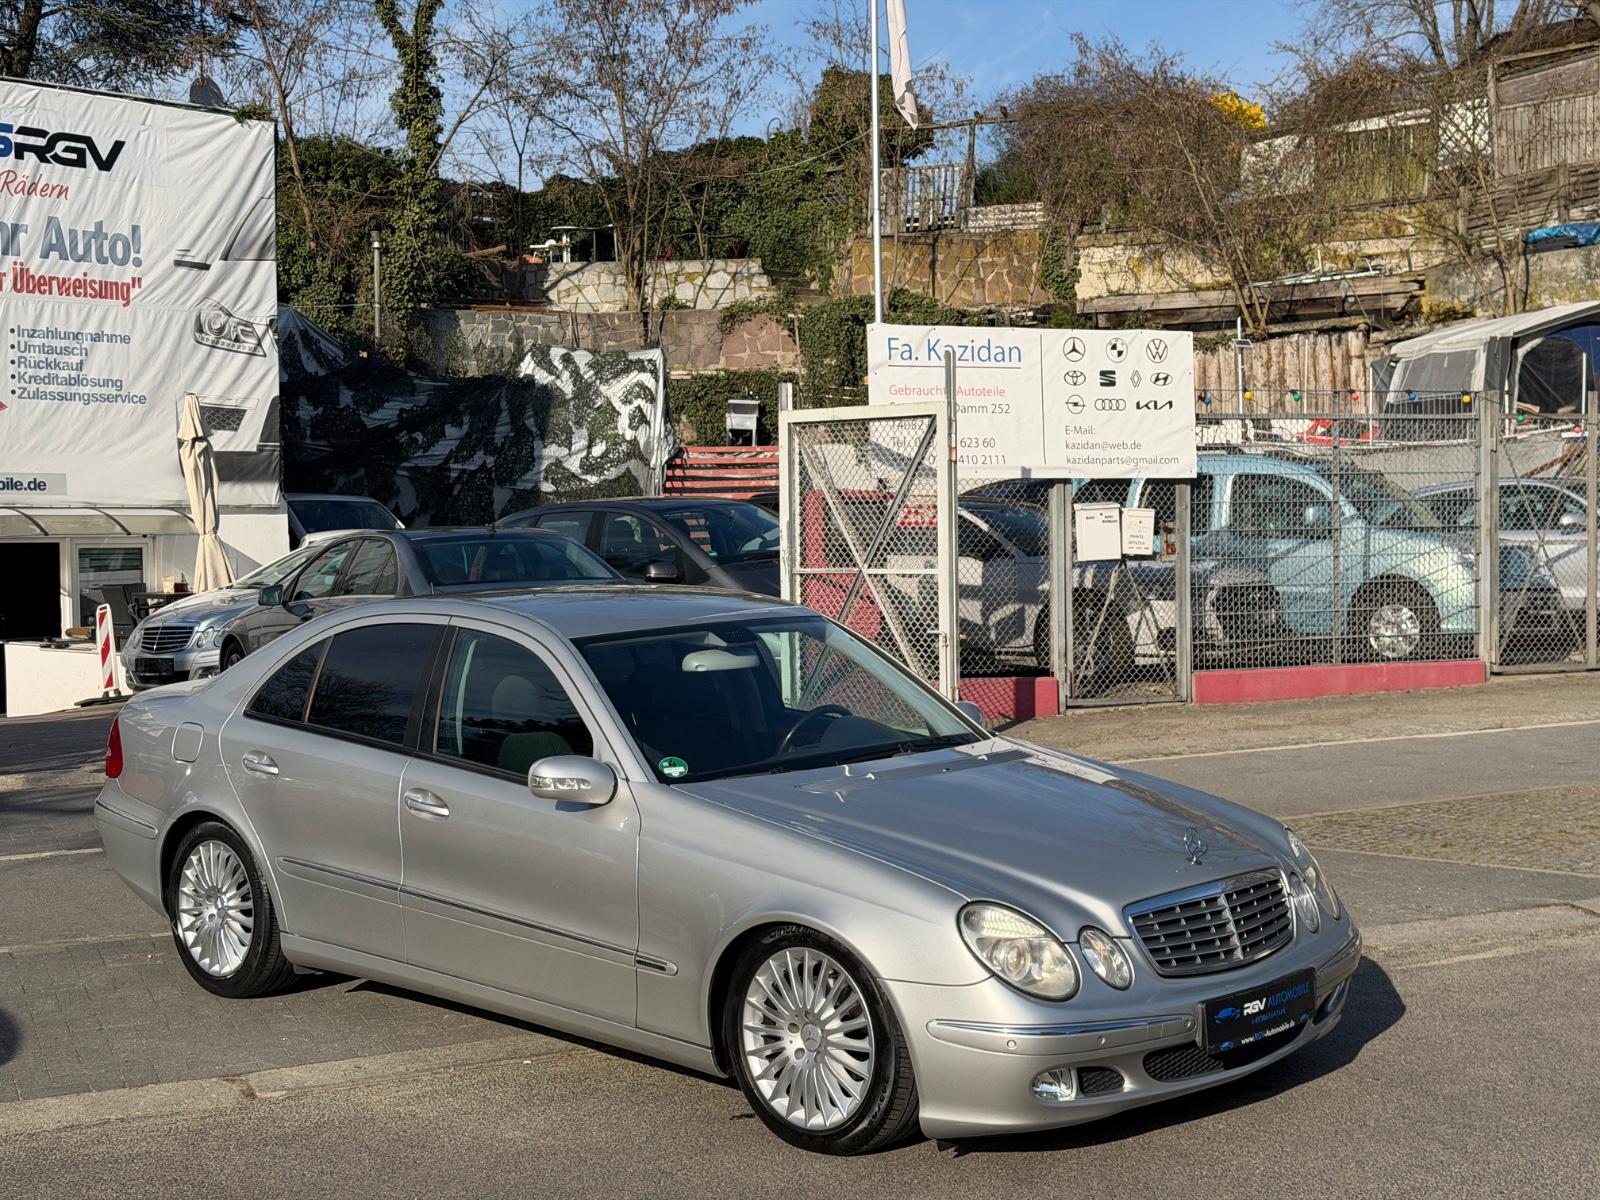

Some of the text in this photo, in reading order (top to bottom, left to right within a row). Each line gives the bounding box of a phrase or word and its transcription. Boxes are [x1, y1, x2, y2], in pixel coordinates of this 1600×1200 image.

[0, 169, 70, 201] Rädern
[40, 215, 143, 267] Auto!
[17, 325, 131, 344] Inzahlungnahme
[17, 340, 88, 357] Umtausch
[887, 337, 919, 361] Fa.
[17, 356, 84, 372] Rückkauf
[17, 372, 123, 391] Kreditablösung
[17, 387, 147, 405] Zulassungsservice
[957, 386, 1006, 397] Autoteile
[991, 404, 1011, 414] 252
[1136, 400, 1173, 410] KIA
[1065, 425, 1096, 435] E-Mail:
[960, 438, 979, 448] 623
[983, 438, 996, 448] 60
[1065, 440, 1142, 451] kazidan@web.de
[958, 455, 1006, 465] 410 2111
[1066, 456, 1180, 467] kazidanparts@gmail.com
[1243, 997, 1267, 1016] RGV
